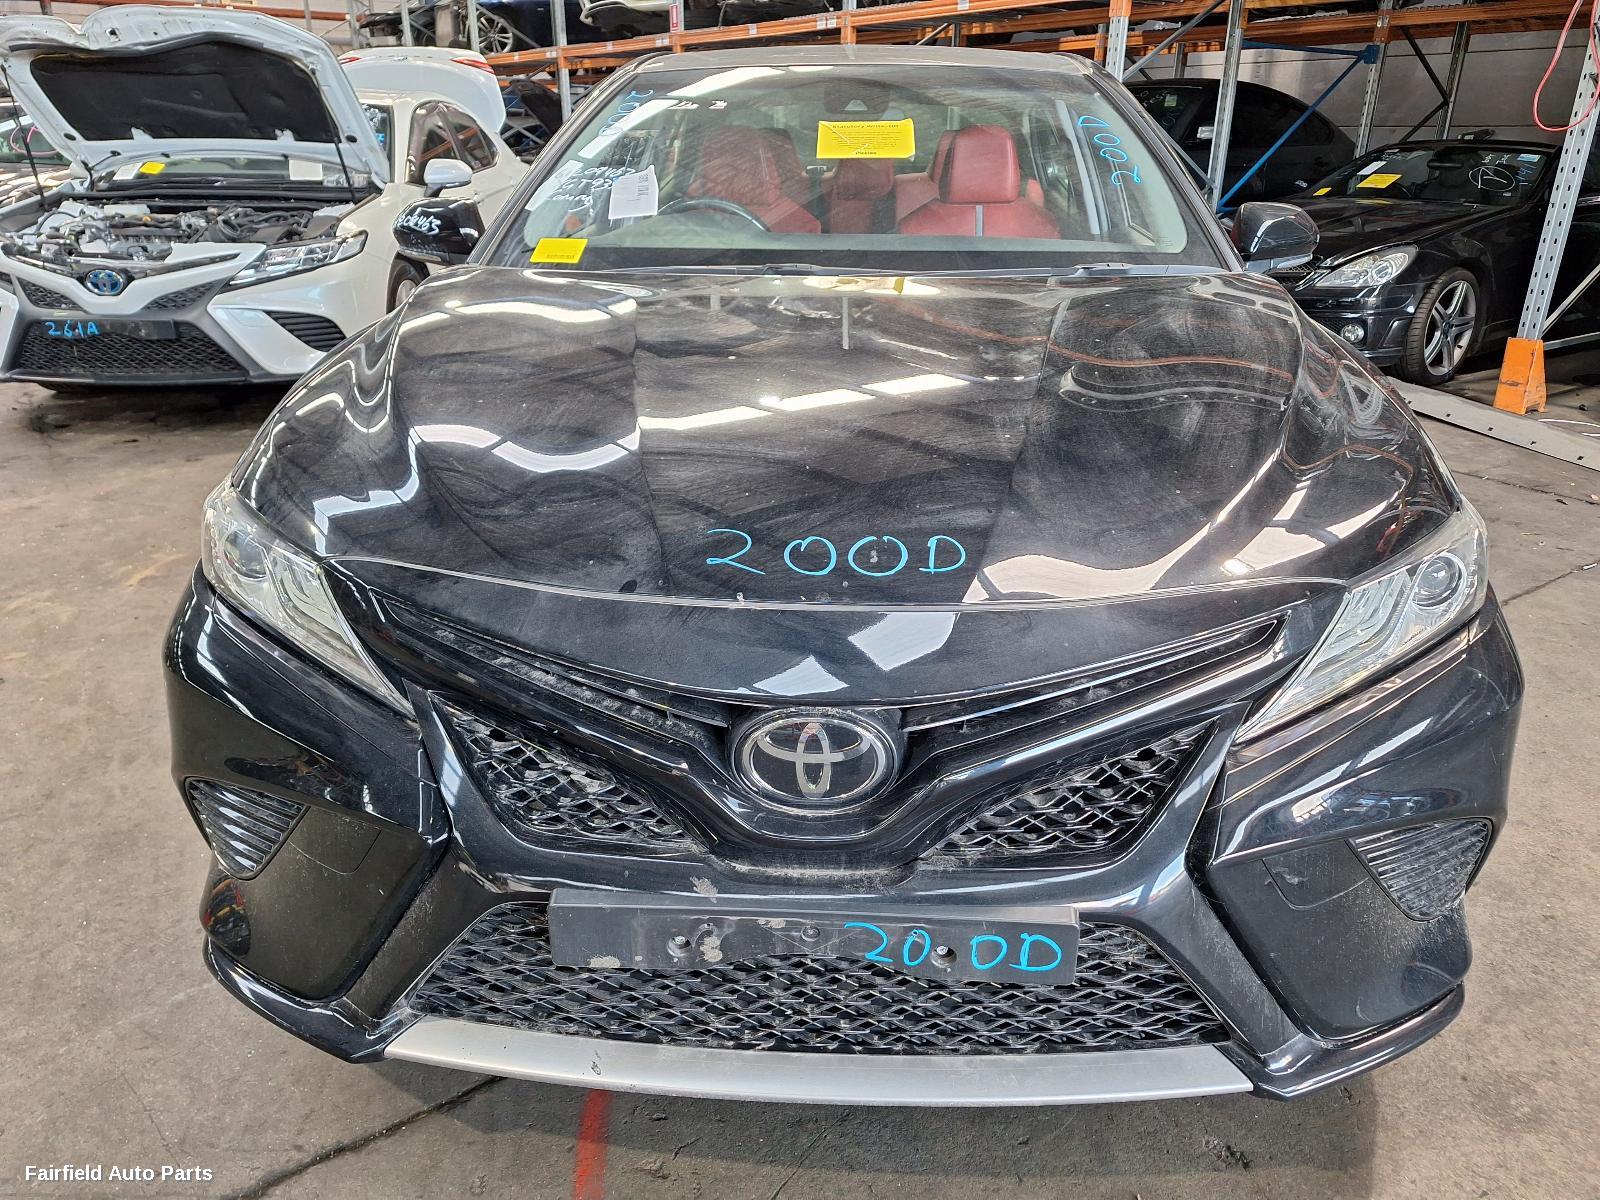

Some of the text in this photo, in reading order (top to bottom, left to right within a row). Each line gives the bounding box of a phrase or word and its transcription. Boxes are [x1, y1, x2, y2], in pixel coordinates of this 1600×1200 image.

[1078, 115, 1141, 185] 200D
[45, 319, 99, 337] 261A
[706, 528, 967, 577] 200D
